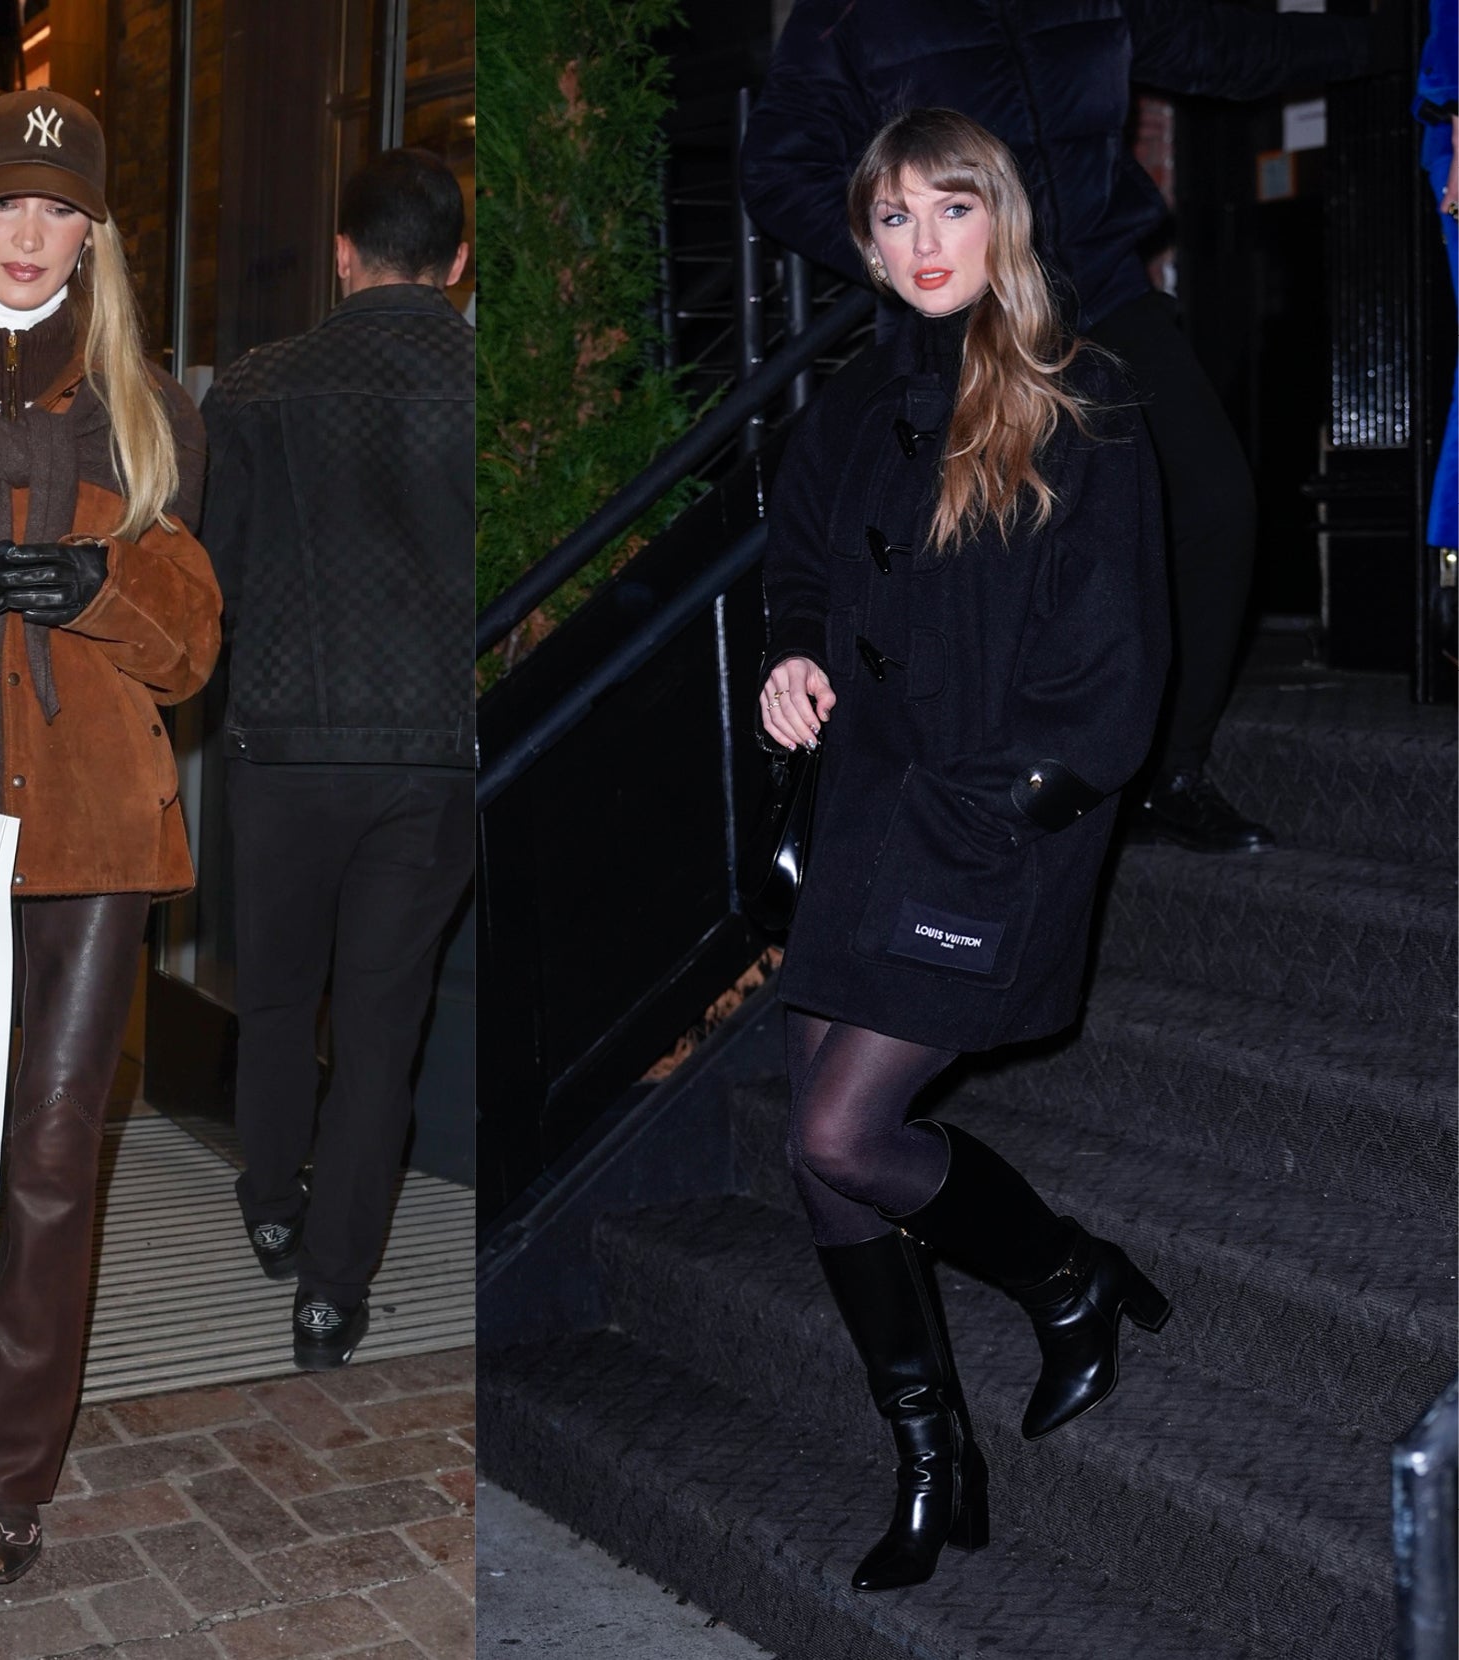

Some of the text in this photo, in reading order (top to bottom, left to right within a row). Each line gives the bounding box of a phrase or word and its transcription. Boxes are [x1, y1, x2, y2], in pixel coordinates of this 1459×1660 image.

[23, 105, 64, 148] NY
[914, 923, 982, 948] LOUIS VUITTON
[940, 941, 955, 950] PARIS
